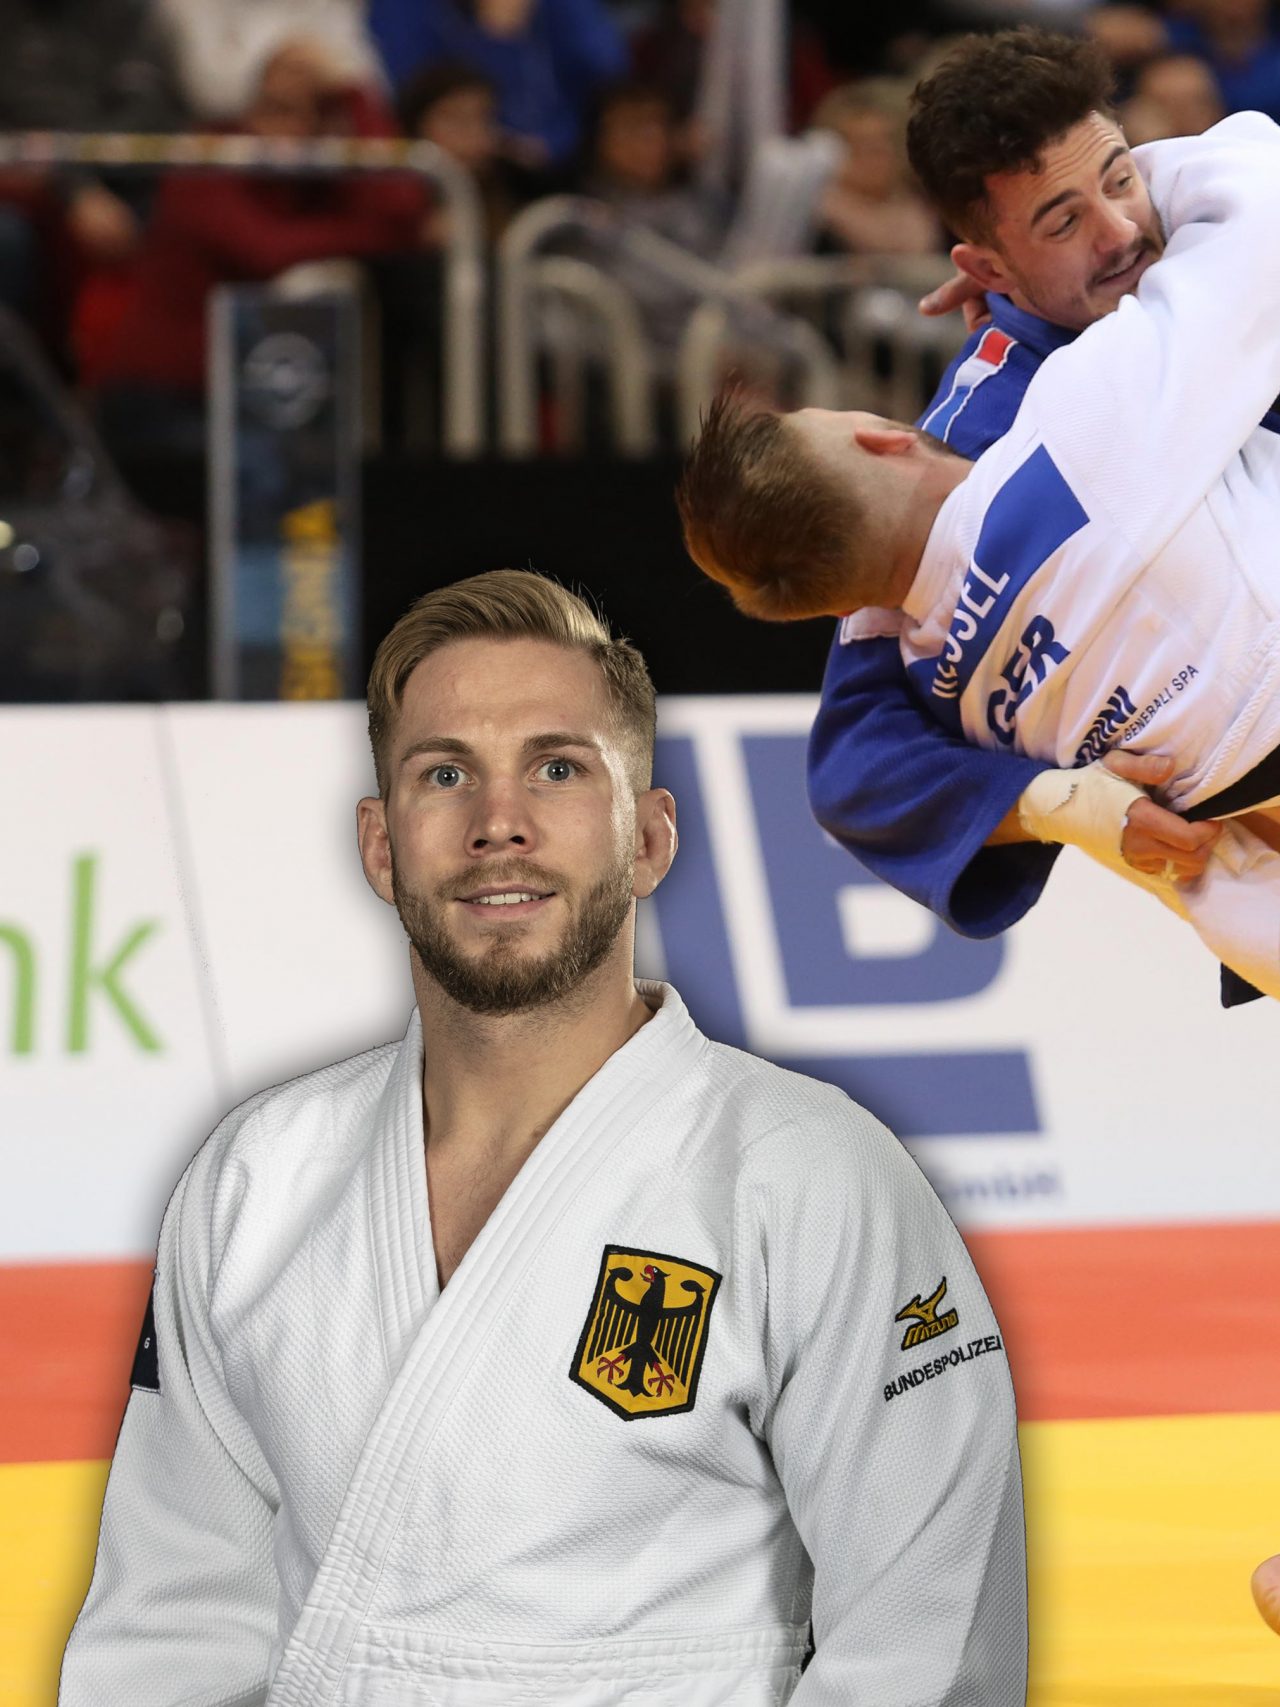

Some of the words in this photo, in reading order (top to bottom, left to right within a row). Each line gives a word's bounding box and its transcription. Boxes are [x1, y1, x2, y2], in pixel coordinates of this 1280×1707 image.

[987, 614, 1071, 746] GER
[1123, 686, 1174, 742] GENERALI
[1171, 663, 1200, 692] SPA
[882, 1334, 1003, 1402] BUNDESPOLIZEI
